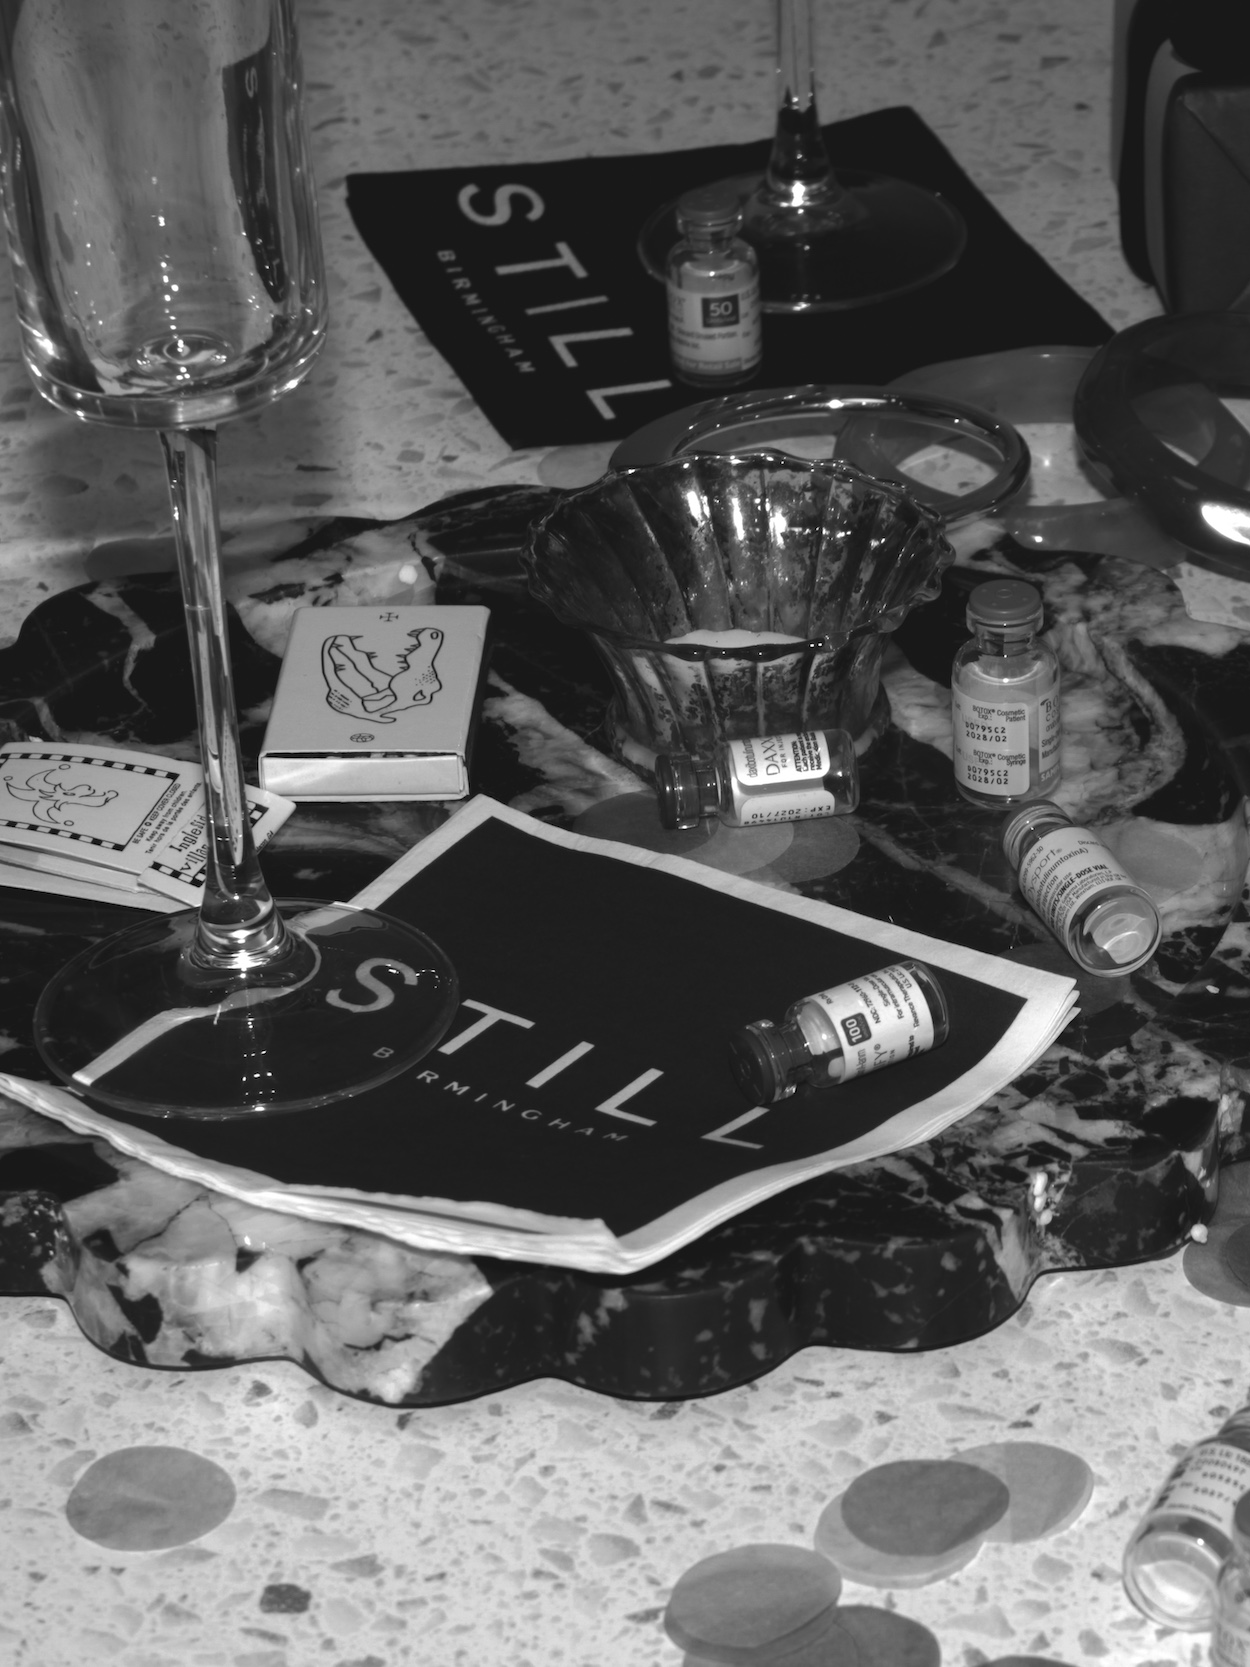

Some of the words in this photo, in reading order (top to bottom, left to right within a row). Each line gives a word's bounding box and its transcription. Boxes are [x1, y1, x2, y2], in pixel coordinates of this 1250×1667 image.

[457, 184, 673, 420] STILL
[709, 301, 733, 317] 50
[437, 249, 535, 374] BIRMINGHAM
[996, 708, 1026, 717] Cosmetic
[1005, 714, 1026, 722] Patient
[966, 730, 1007, 743] 2028/02
[997, 752, 1026, 761] Cosmetic
[1006, 759, 1027, 767] Syringe
[967, 772, 1009, 785] 2028/02
[136, 827, 149, 838] SAFE
[149, 810, 160, 821] KEEP
[156, 797, 169, 811] COVER
[165, 783, 181, 798] CLOSED
[751, 808, 802, 820] 2027/10
[145, 830, 158, 842] Keep
[155, 818, 168, 830] away
[162, 808, 174, 818] from
[145, 843, 157, 854] Tenir
[154, 833, 165, 843] hors
[180, 798, 190, 806] des
[1091, 863, 1109, 871] VIAL
[1062, 871, 1073, 881] use
[845, 1018, 863, 1043] 100
[325, 957, 771, 1150] STILL
[371, 1046, 629, 1143] BRMINGHAM
